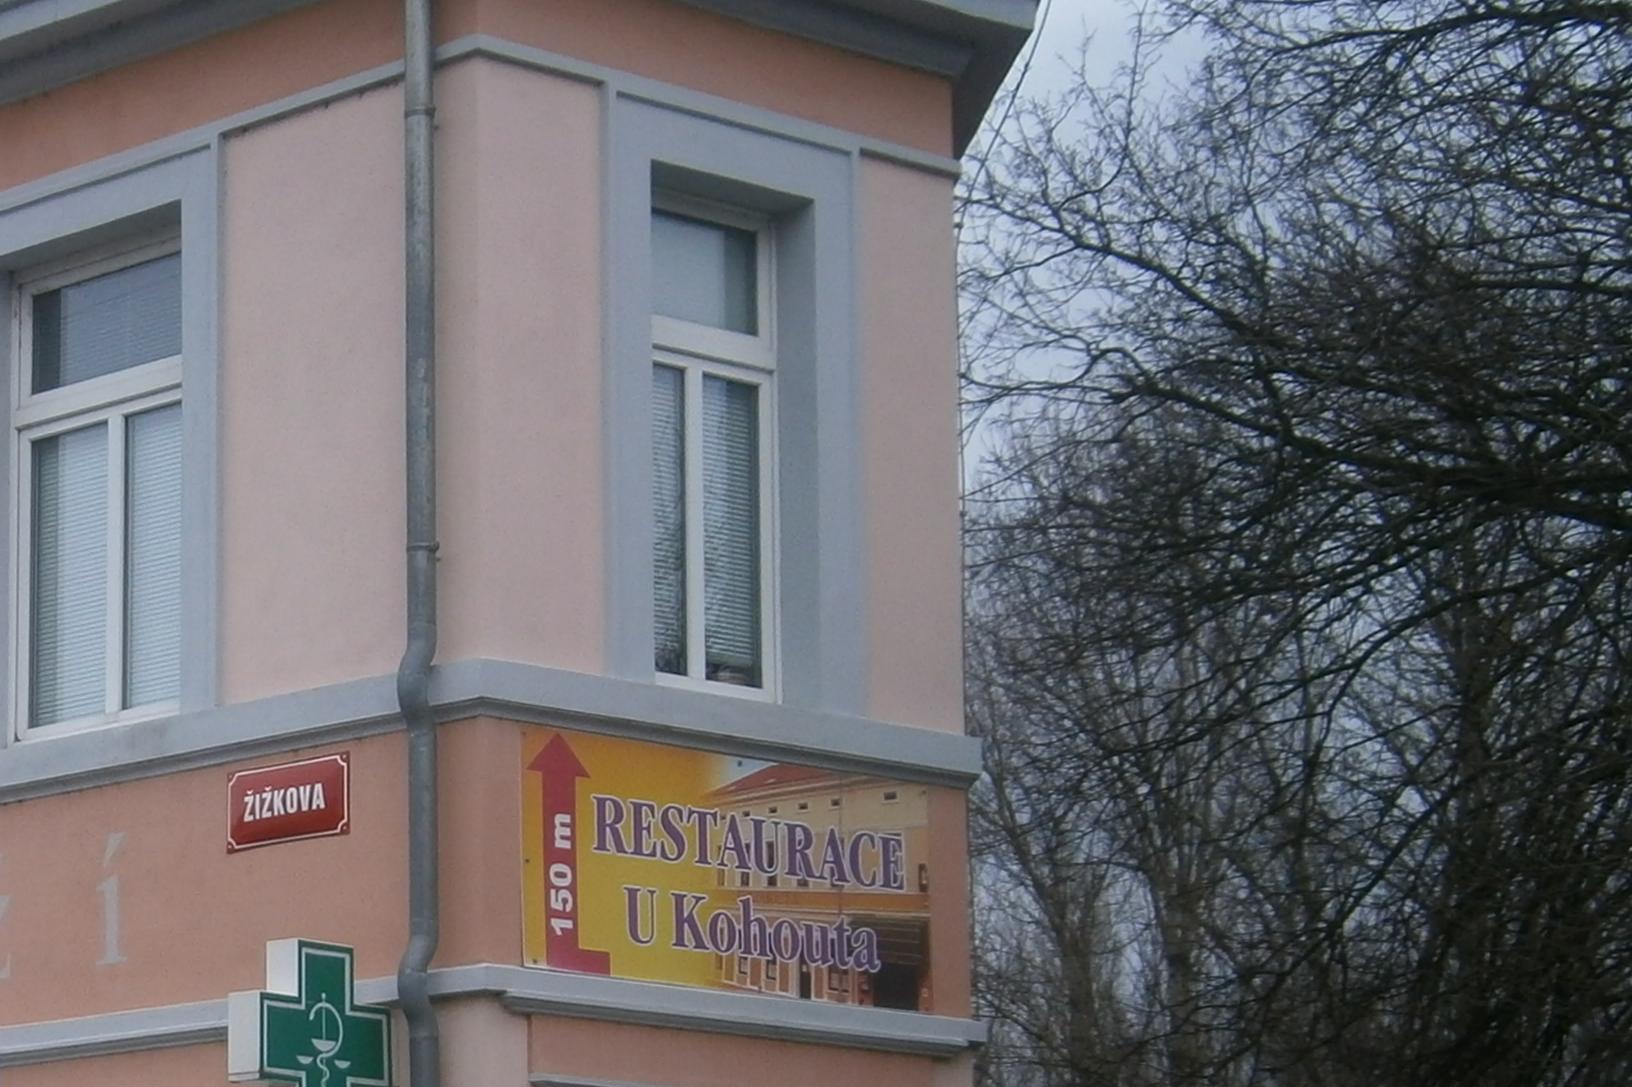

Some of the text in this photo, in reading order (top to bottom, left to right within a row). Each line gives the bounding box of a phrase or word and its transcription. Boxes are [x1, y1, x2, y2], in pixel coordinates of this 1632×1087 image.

[244, 782, 325, 823] ŽIŽKOVA
[592, 794, 906, 892] RESTAURACE
[550, 813, 574, 936] 150 m
[624, 886, 881, 974] U Kohouta
